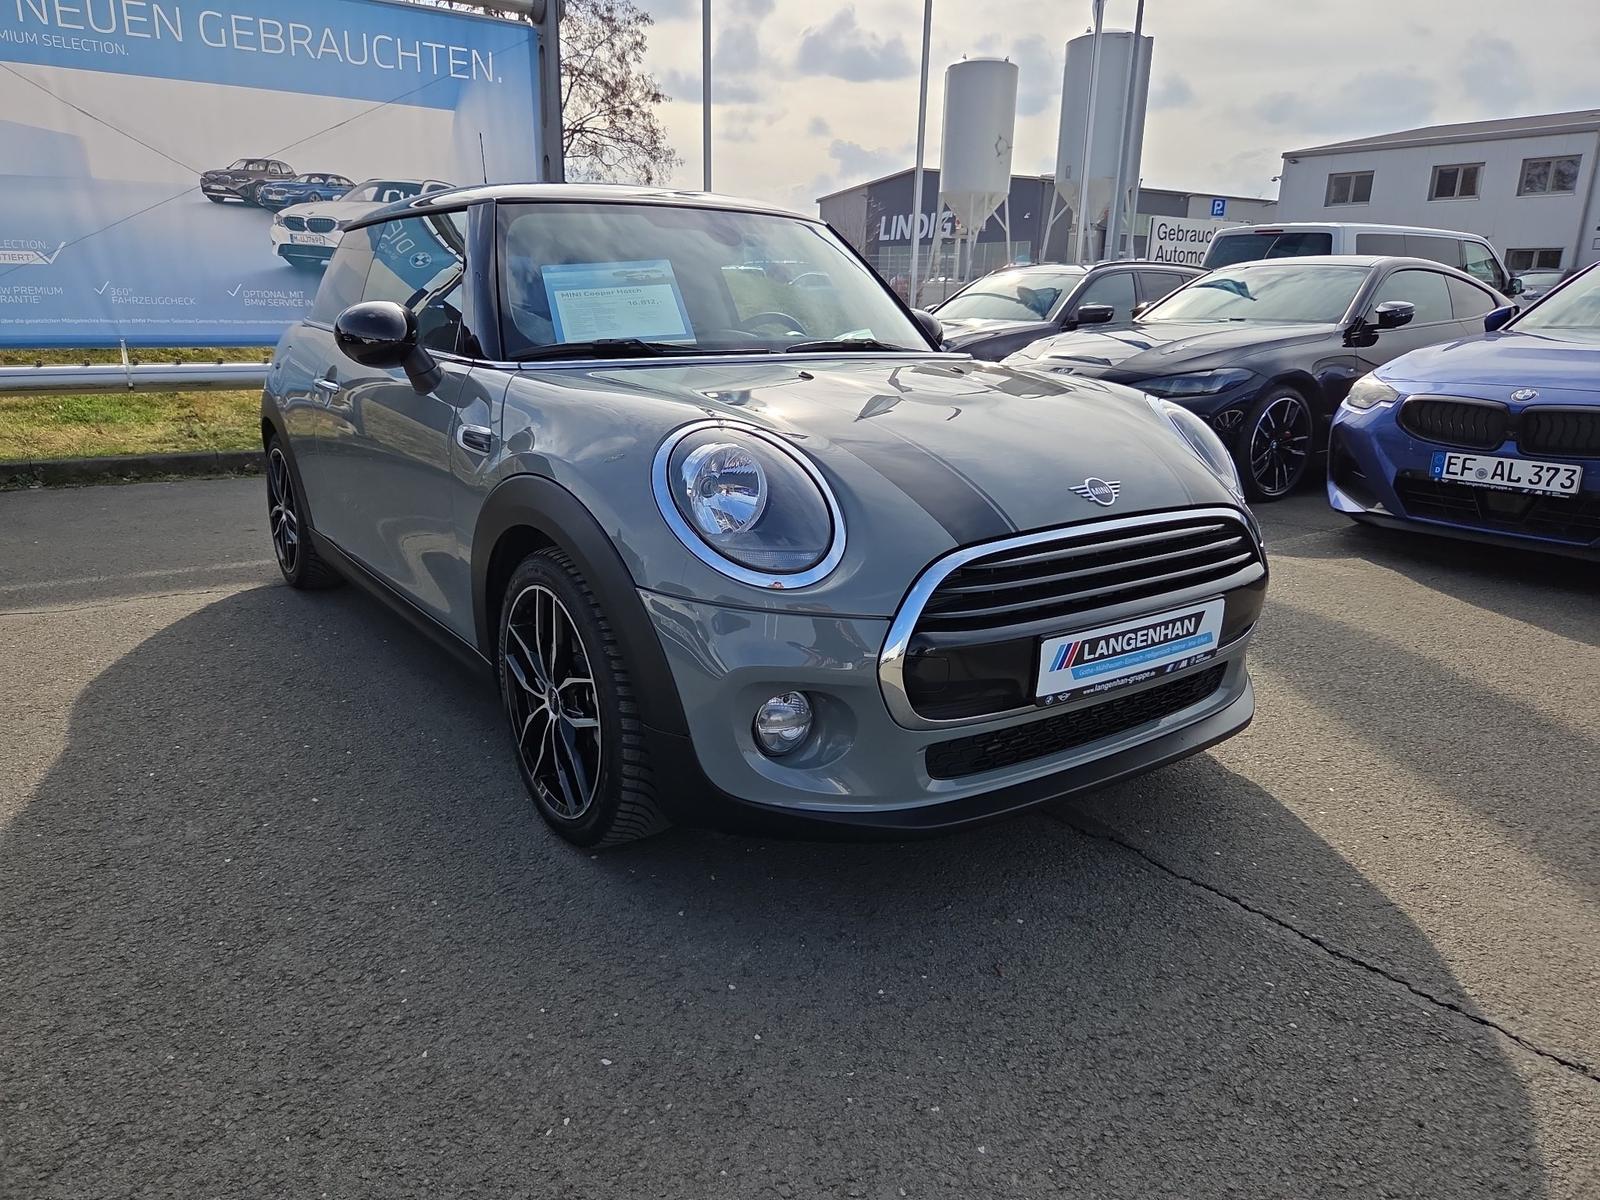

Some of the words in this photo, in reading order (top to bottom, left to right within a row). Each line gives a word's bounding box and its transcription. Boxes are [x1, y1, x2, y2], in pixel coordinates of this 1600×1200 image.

[15, 0, 183, 42] NEUEN
[199, 10, 502, 83] GEBRAUCHTEN.
[42, 33, 129, 56] SELECTION.
[13, 286, 63, 295] PREMIUM
[110, 287, 132, 296] 360°
[243, 290, 287, 299] OPTIONAL
[289, 290, 304, 298] MIT
[561, 291, 582, 299] MINI
[112, 296, 196, 306] FAHRZEUGCHECK
[244, 298, 266, 306] BMW
[268, 299, 304, 307] SERVICE
[1445, 455, 1477, 477] EF
[1490, 460, 1522, 483] AL
[1527, 464, 1577, 490] 373
[1083, 617, 1195, 661] LANGENHAN
[1083, 671, 1156, 695] www.langenhan-gruppe.de
